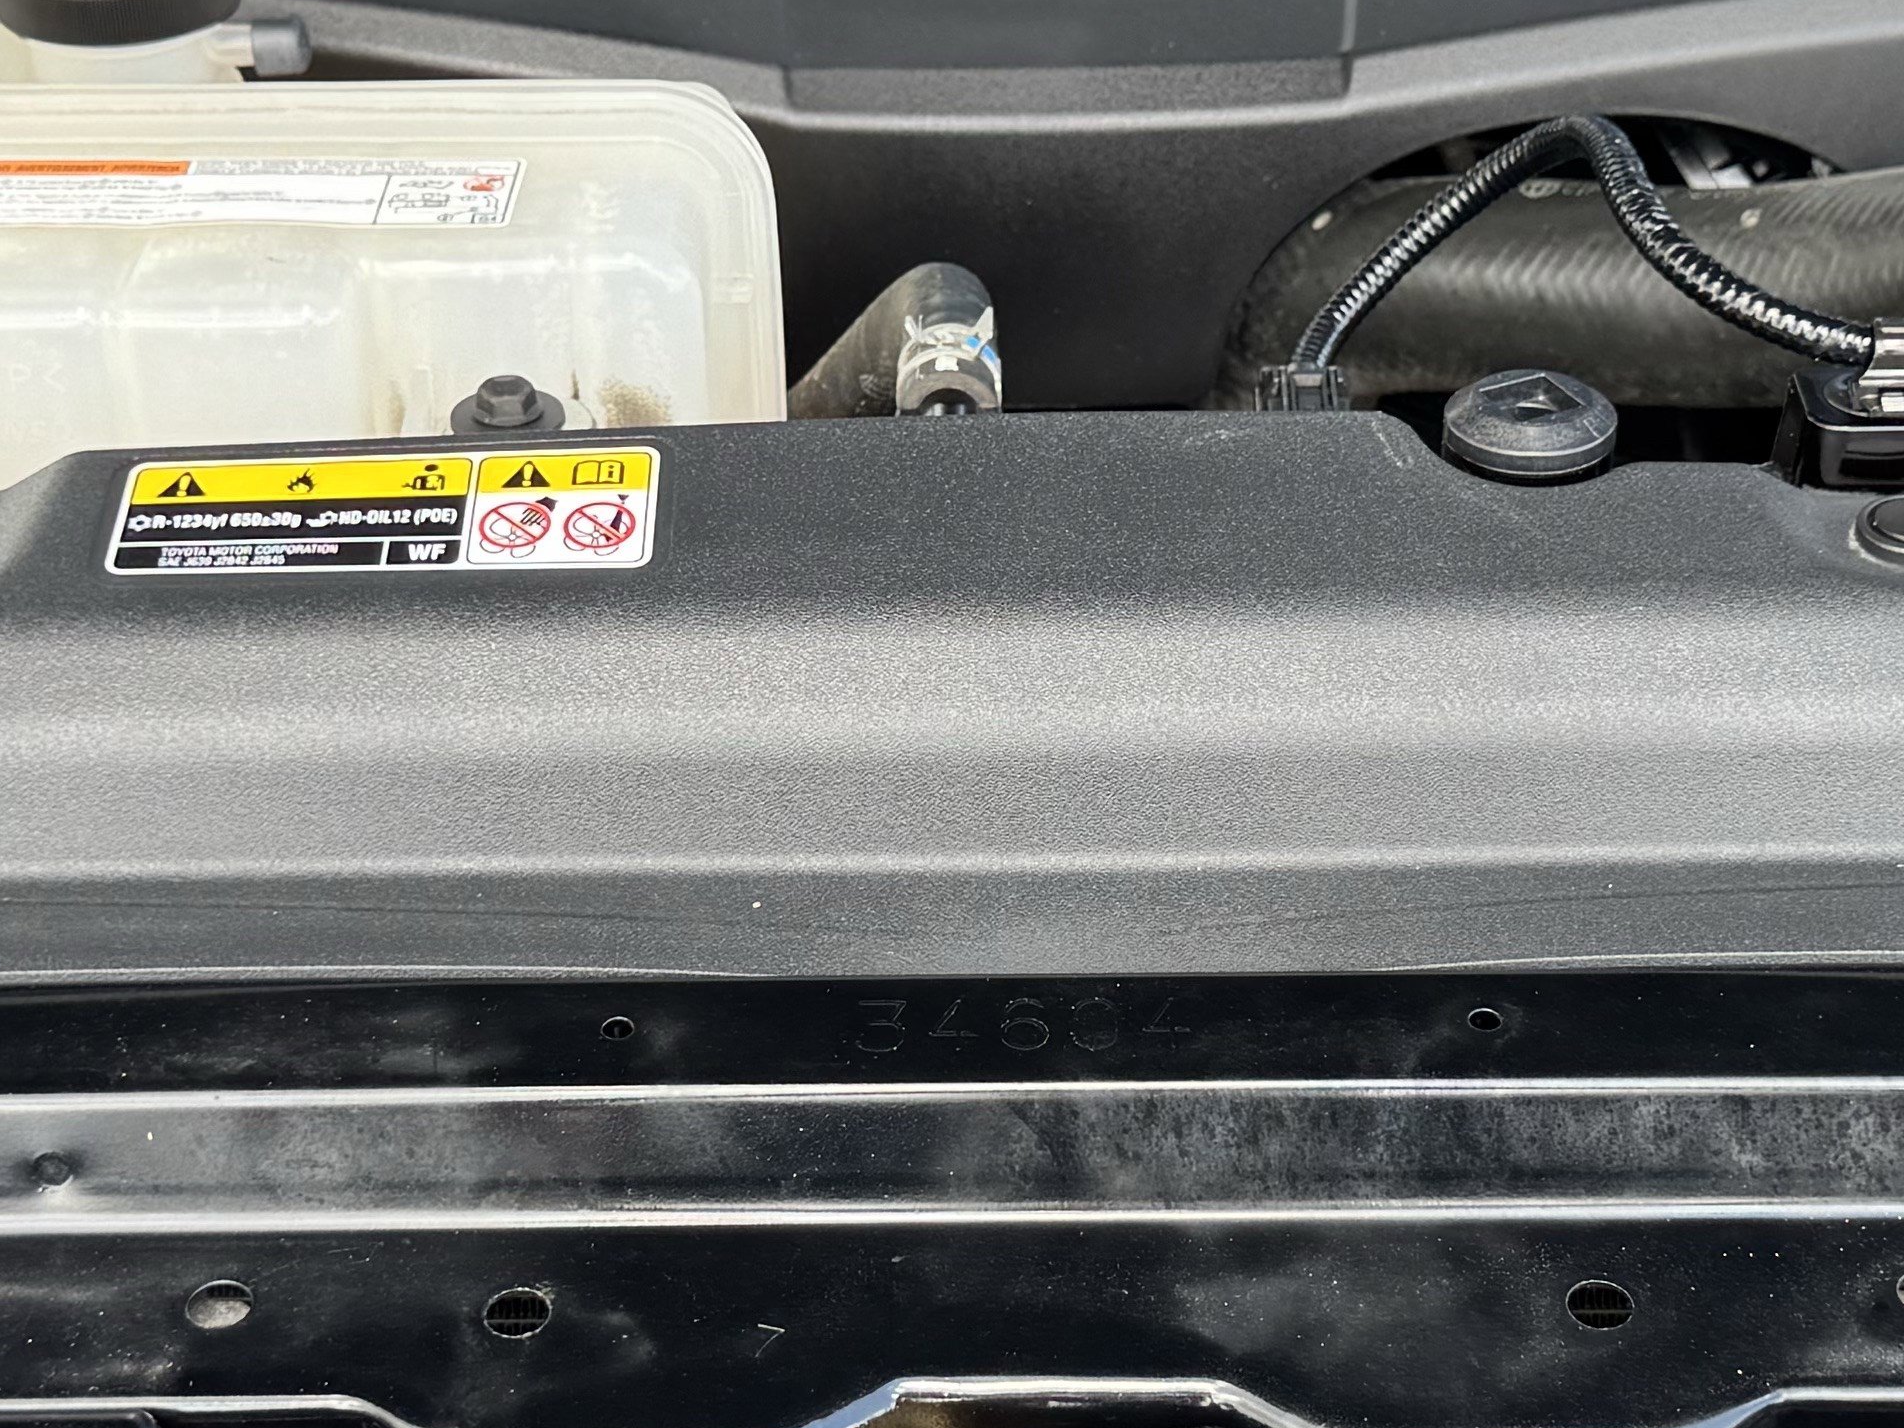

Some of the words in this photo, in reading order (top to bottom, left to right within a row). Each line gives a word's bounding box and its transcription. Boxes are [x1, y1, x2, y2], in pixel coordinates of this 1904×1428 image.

[413, 507, 458, 527] (POE)
[161, 546, 207, 557] TOYOTA
[208, 545, 253, 556] MOTOR
[254, 543, 339, 556] CORPORATION
[407, 543, 447, 561] WF
